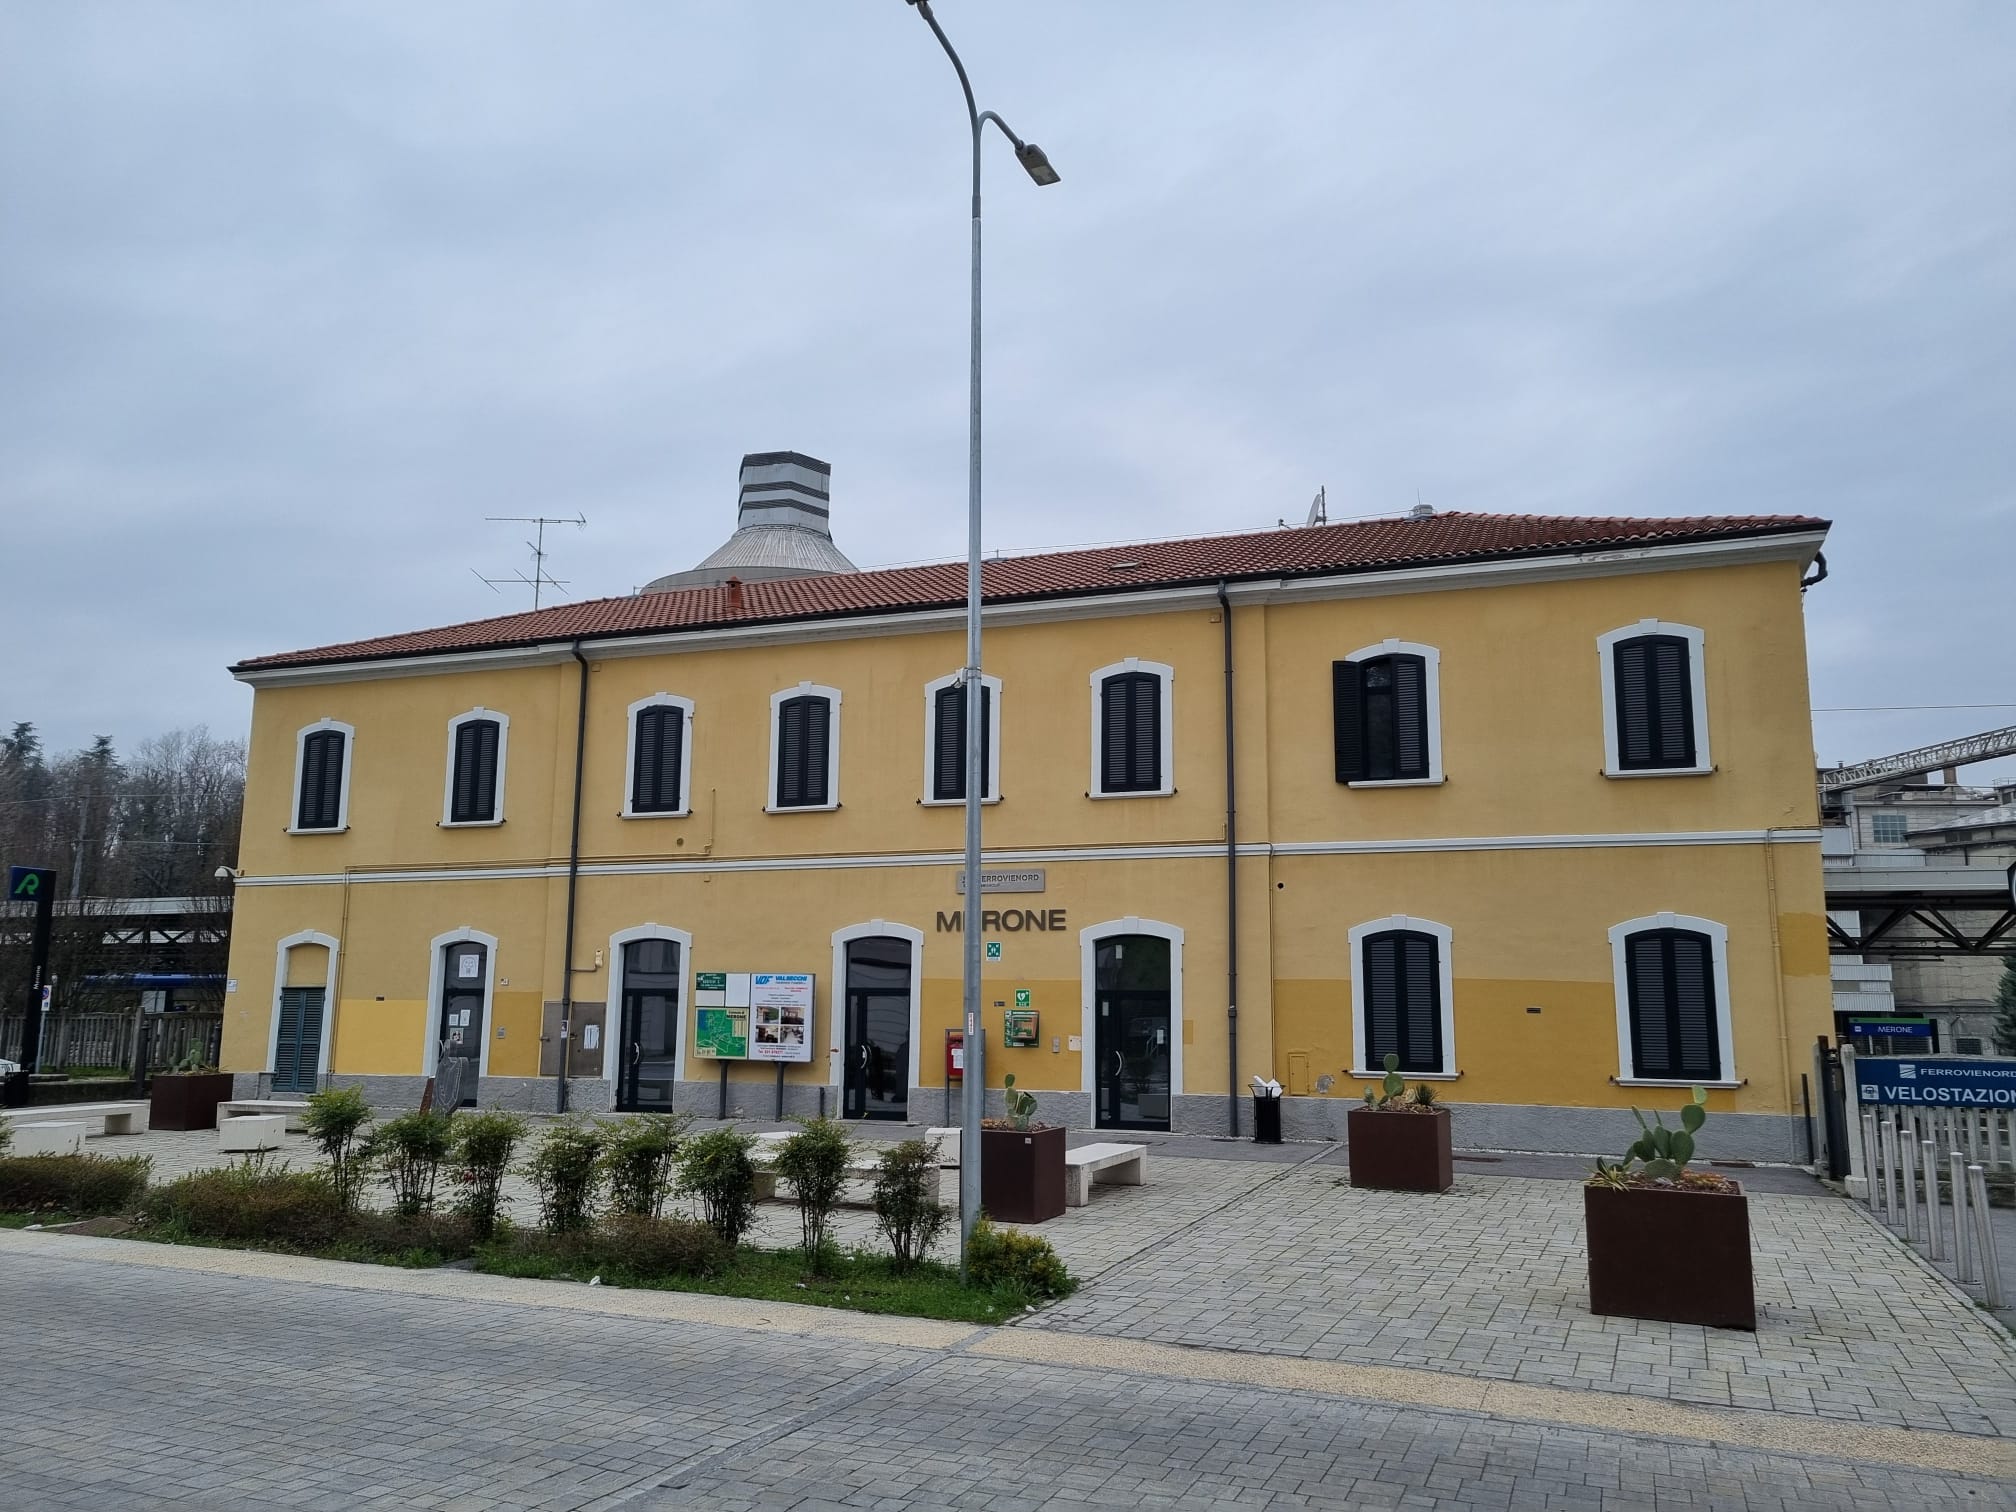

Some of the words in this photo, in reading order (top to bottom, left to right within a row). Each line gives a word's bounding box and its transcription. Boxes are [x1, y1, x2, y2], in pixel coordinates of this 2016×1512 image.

[981, 874, 1040, 883] ERROVIENORD
[936, 909, 1067, 932] MRONE
[1877, 1026, 1913, 1034] MERONE
